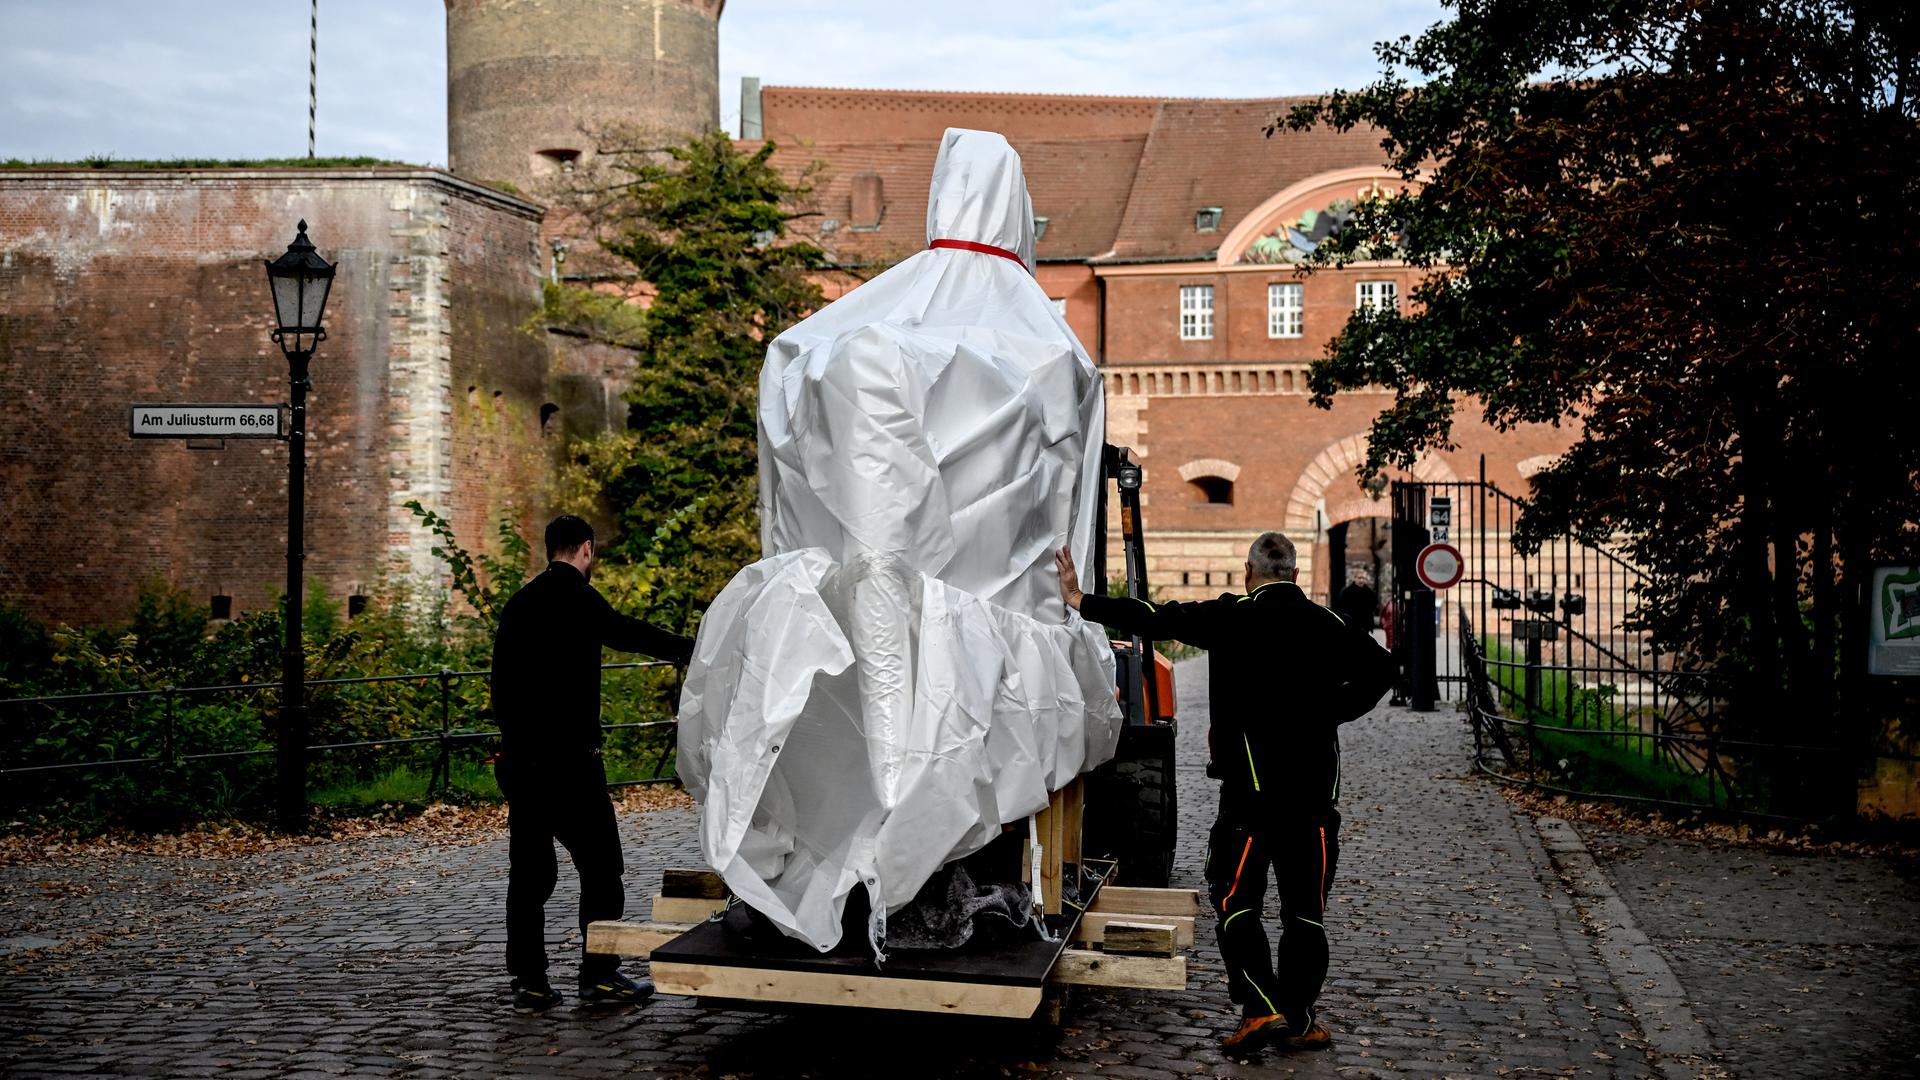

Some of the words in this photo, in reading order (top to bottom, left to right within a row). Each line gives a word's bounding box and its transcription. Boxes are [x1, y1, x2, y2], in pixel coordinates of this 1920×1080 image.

[141, 414, 163, 426] Am
[167, 414, 236, 426] Juliusturm
[240, 414, 275, 428] 66,68
[1431, 510, 1449, 524] 64
[1433, 531, 1447, 541] 64
